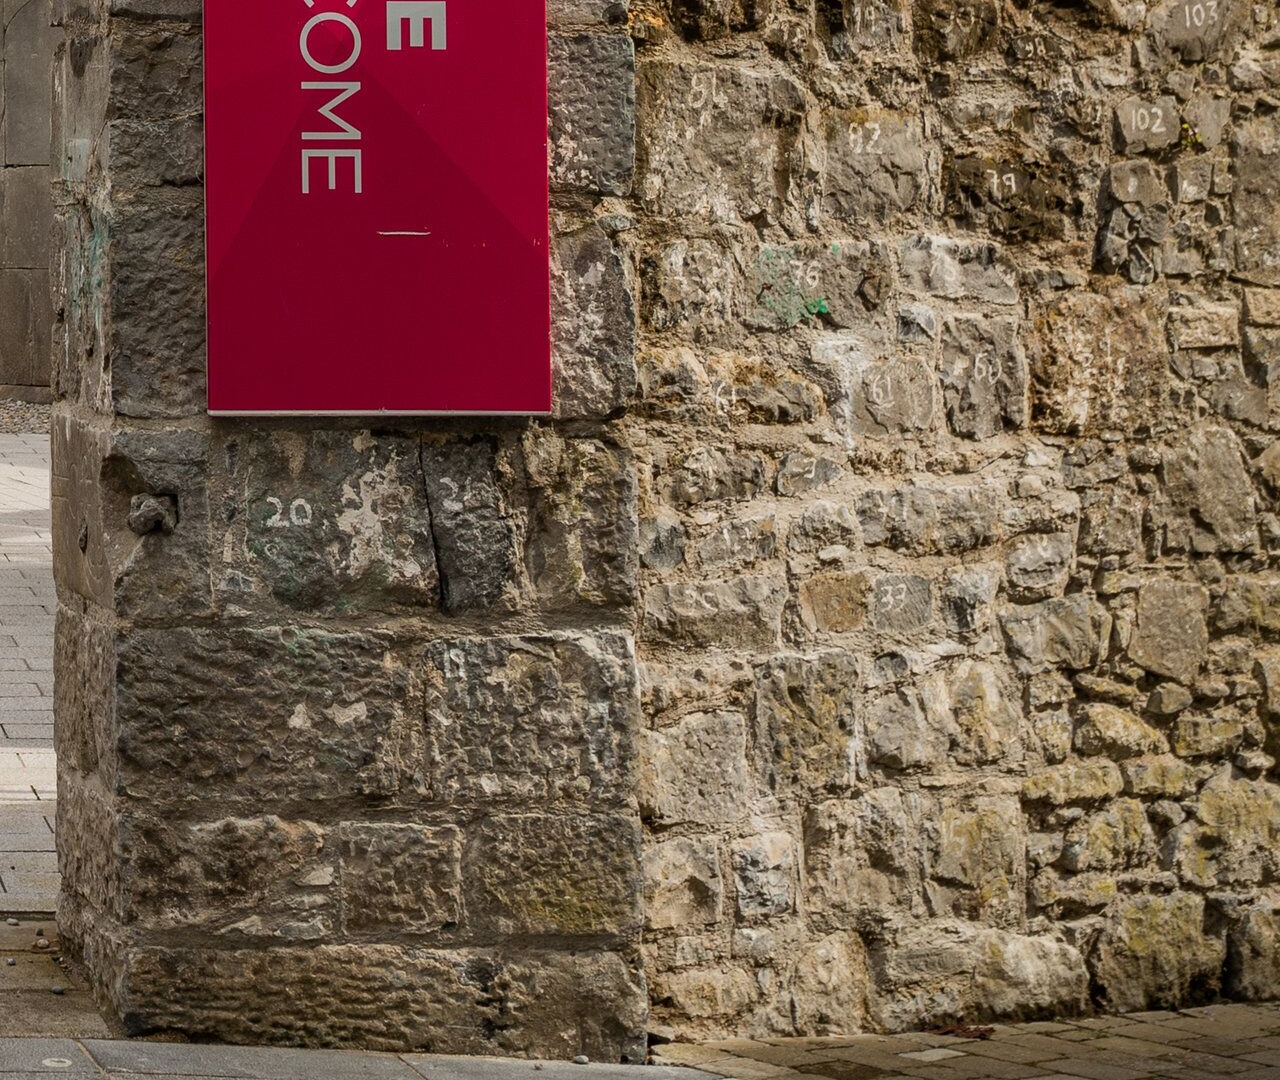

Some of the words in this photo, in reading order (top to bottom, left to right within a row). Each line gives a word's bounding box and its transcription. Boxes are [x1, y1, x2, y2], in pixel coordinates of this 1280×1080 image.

[1184, 0, 1218, 28] 103
[1131, 107, 1166, 134] 102
[266, 496, 312, 528] 20
